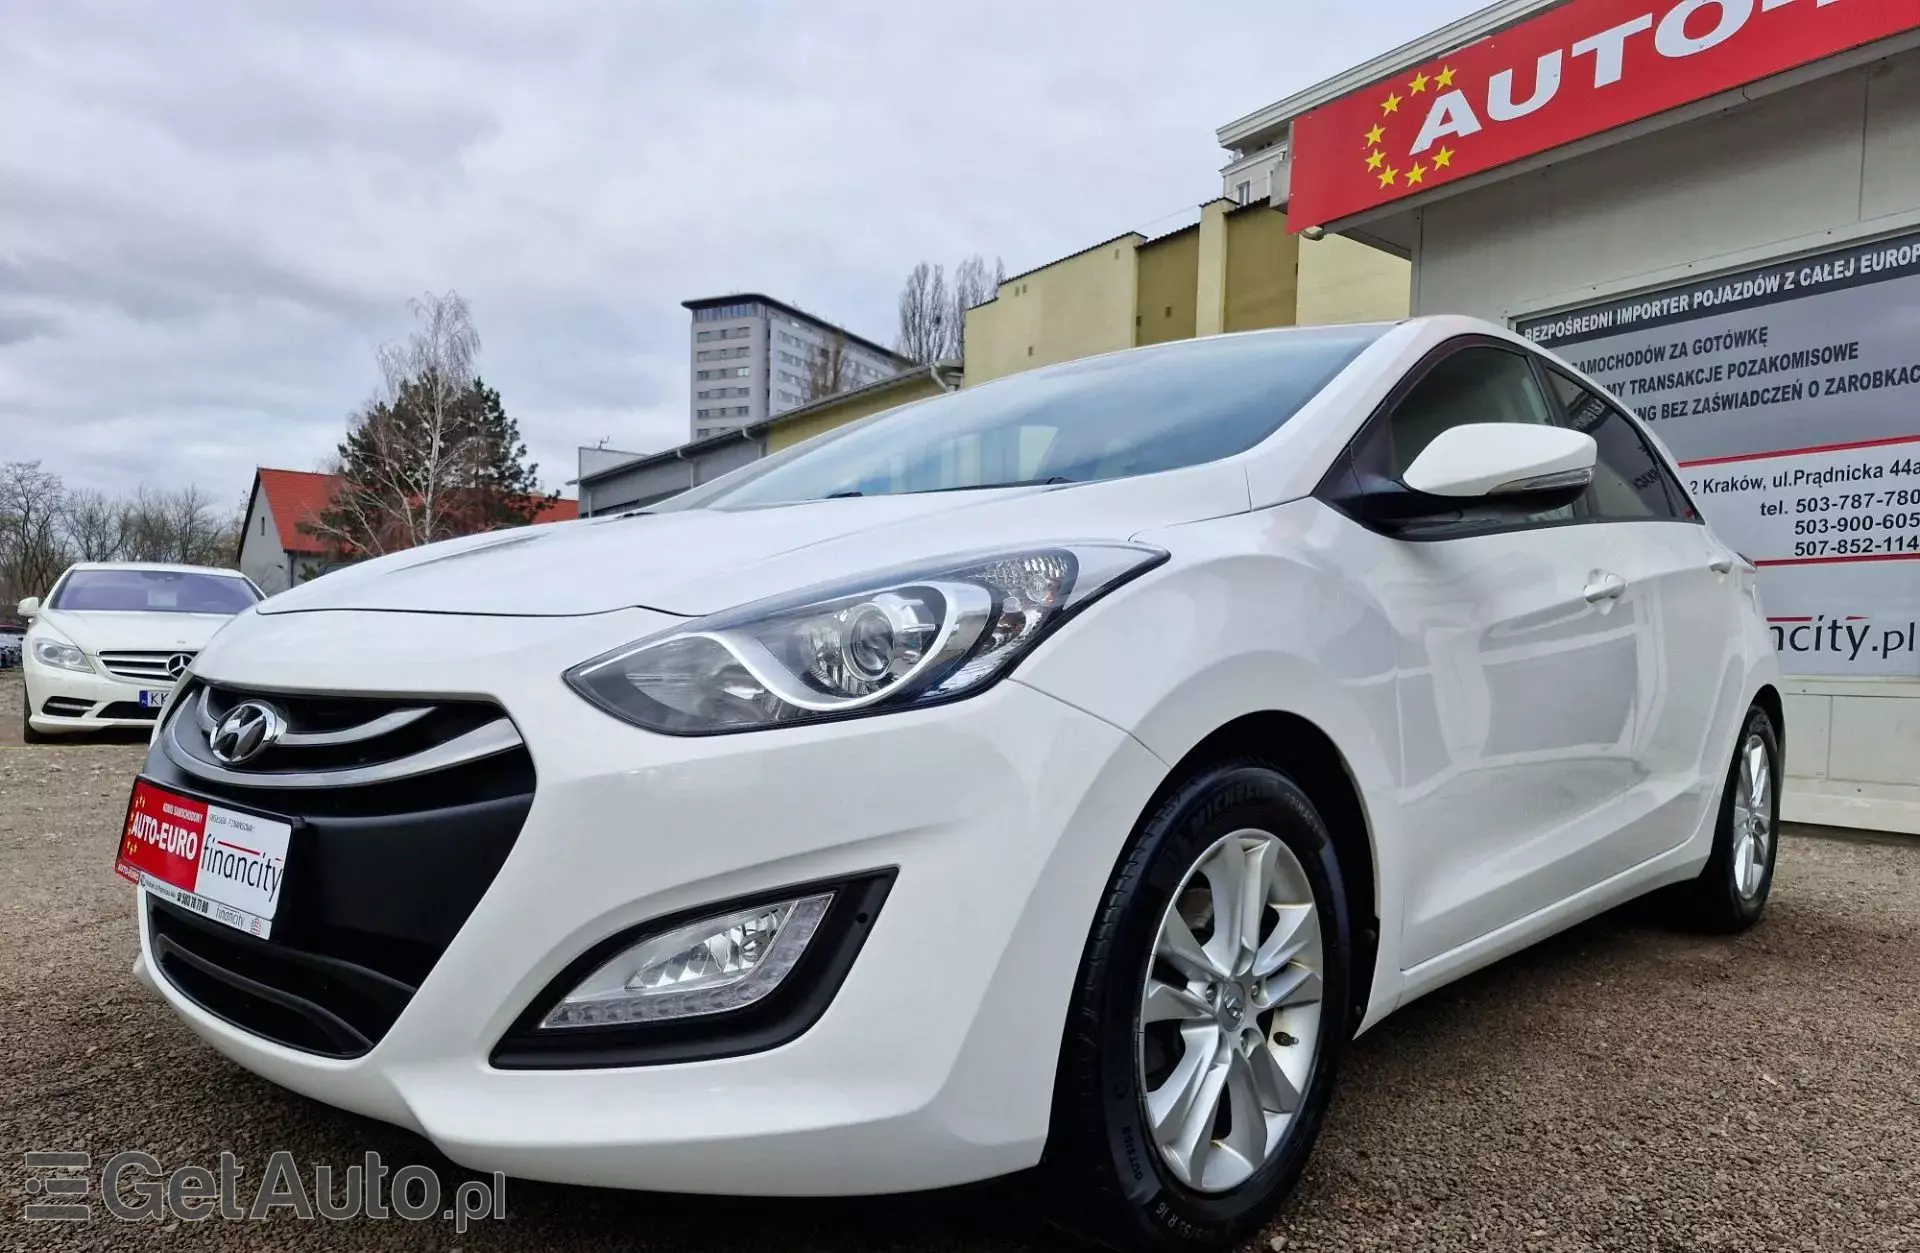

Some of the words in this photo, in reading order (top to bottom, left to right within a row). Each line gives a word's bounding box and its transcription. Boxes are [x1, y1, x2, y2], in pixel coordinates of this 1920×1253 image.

[1525, 311, 1613, 343] BEZPOŚREDNI
[1617, 295, 1689, 325] IMPORTER
[1693, 274, 1780, 309] POJAZDÓW
[1784, 271, 1796, 291] Z
[1800, 258, 1855, 287] CAŁEJ
[1670, 342, 1689, 361] ZA
[1692, 326, 1769, 353] GOTÓWKĘ
[1630, 365, 1723, 396] TRANSAKCJE
[1728, 342, 1859, 380] POZAKOMISOWE
[1661, 401, 1688, 419] BEZ
[1692, 379, 1803, 416] ZAŚWIADCZEŃ
[1808, 380, 1820, 398] O
[1703, 475, 1767, 495] Kraków,
[1772, 463, 1884, 488] ul.Prądnicka
[1889, 458, 1920, 477] 44a
[1760, 501, 1789, 517] tel.
[1795, 489, 1920, 514] 503-787-780
[1794, 512, 1920, 535] 503-900-605
[1794, 535, 1920, 557] 507-852-114
[131, 812, 198, 861] AUTO-EURO
[201, 834, 283, 902] financity
